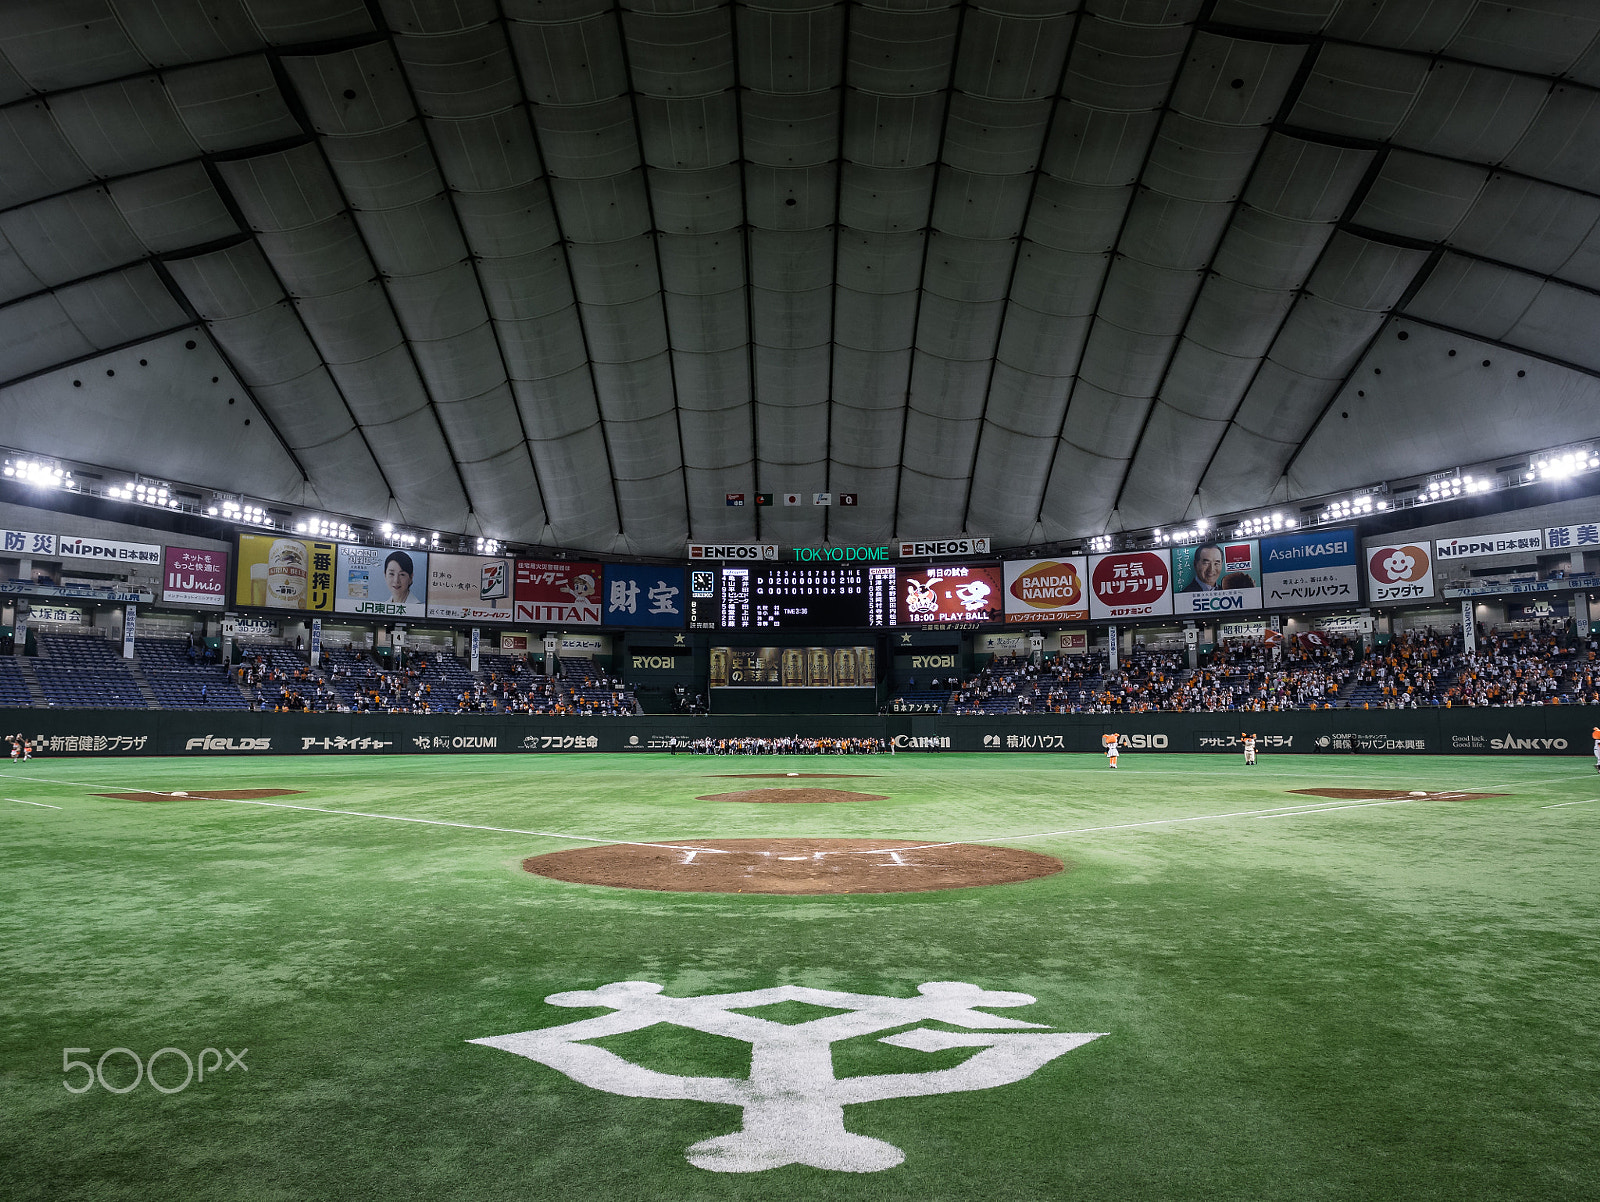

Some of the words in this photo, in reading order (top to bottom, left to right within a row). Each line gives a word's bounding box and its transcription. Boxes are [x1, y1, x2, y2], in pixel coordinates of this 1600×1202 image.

[5, 531, 52, 554] 防災
[1548, 525, 1599, 547] 能美
[61, 540, 117, 558] NIPPN
[119, 549, 159, 562] 日本製粉
[704, 546, 757, 558] ENEOS
[915, 541, 968, 555] ENEOS
[1438, 540, 1494, 556] NIPPN
[1496, 537, 1540, 551] 日本製粉
[182, 553, 211, 563] ネットを
[793, 548, 843, 561] TOKYO
[846, 547, 889, 560] DOME
[174, 561, 220, 572] もっと快適に
[927, 567, 969, 578] 明日の試合
[1112, 562, 1145, 578] 元気
[1227, 562, 1250, 570] SECOM
[312, 543, 331, 609] 一番搾り
[432, 571, 452, 579] 日本の
[517, 571, 568, 585] ニッタン
[1022, 575, 1073, 587] BANDAI
[1, 583, 32, 592] センター
[169, 573, 221, 591] IIJmio
[608, 580, 680, 615] 財宝
[1022, 587, 1074, 599] NAMCO
[1271, 584, 1350, 599] ヘーベルハウス
[1377, 585, 1424, 599] シマダヤ
[355, 602, 407, 615] JR東日本
[1192, 596, 1243, 611] SECOM
[1523, 604, 1555, 614] GALA
[517, 604, 599, 622] NITTAN
[909, 613, 935, 621] 18:00
[939, 613, 963, 621] PLAY
[966, 611, 989, 619] BALL
[1010, 613, 1055, 622] バンダイナムコ
[1056, 611, 1084, 620] グループ
[1109, 607, 1152, 616] オロナミンC
[1223, 623, 1263, 635] 昭和大学
[632, 656, 675, 669] RYOBI
[911, 656, 955, 668] RYOBI
[49, 735, 148, 751] 新宿健診プラザ
[301, 736, 393, 750] アートネイチャー
[452, 736, 497, 748] OIZUMI
[540, 735, 599, 748] フコク生命
[894, 734, 951, 748] Cann
[1006, 735, 1065, 748] 積水ハウス
[1490, 733, 1568, 750] SANKYO
